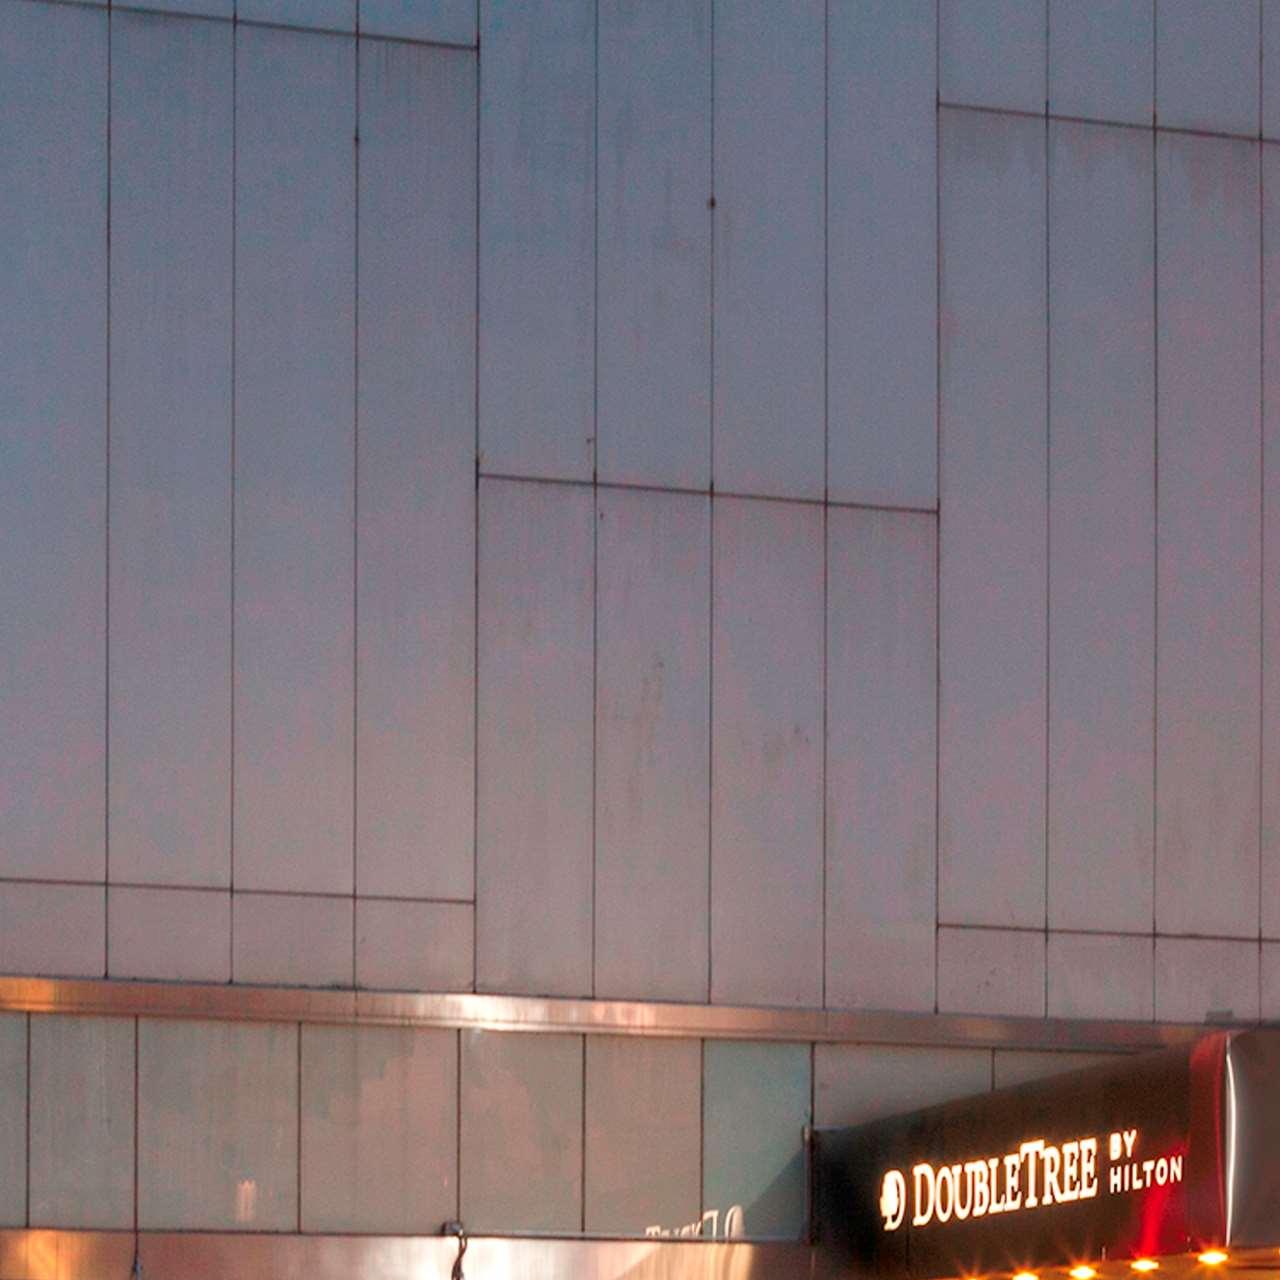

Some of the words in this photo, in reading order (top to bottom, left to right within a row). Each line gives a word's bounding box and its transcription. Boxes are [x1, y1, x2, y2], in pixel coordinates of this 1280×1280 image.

[1109, 1129, 1138, 1161] BY
[912, 1137, 1098, 1227] DOUBLETREE
[1109, 1155, 1184, 1194] HILTON
